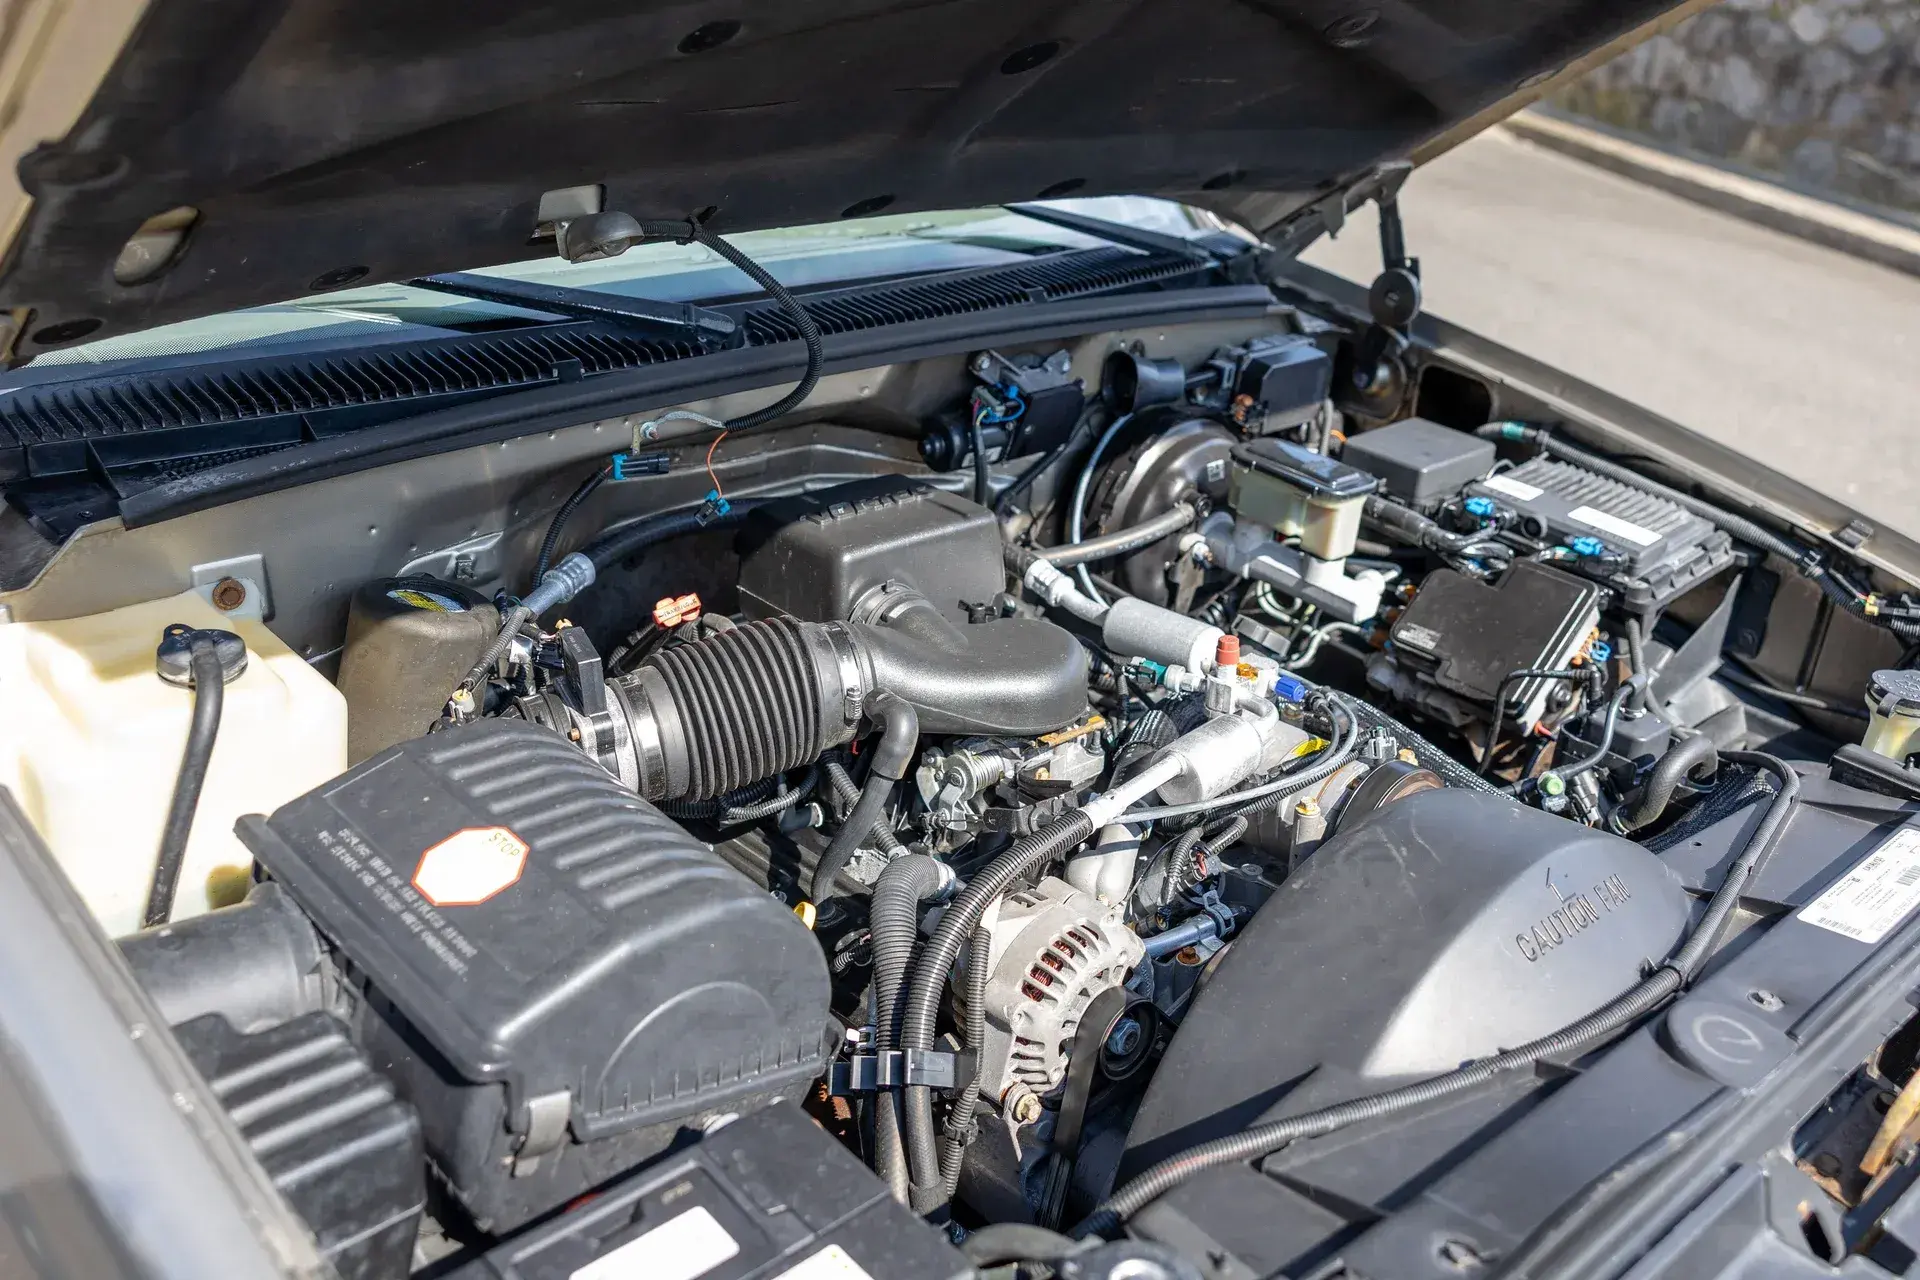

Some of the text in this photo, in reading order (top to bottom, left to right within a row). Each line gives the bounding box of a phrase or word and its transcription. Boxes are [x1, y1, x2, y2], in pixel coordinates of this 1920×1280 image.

[488, 831, 520, 857] STOP
[1515, 873, 1632, 962] CAUTION FAN
